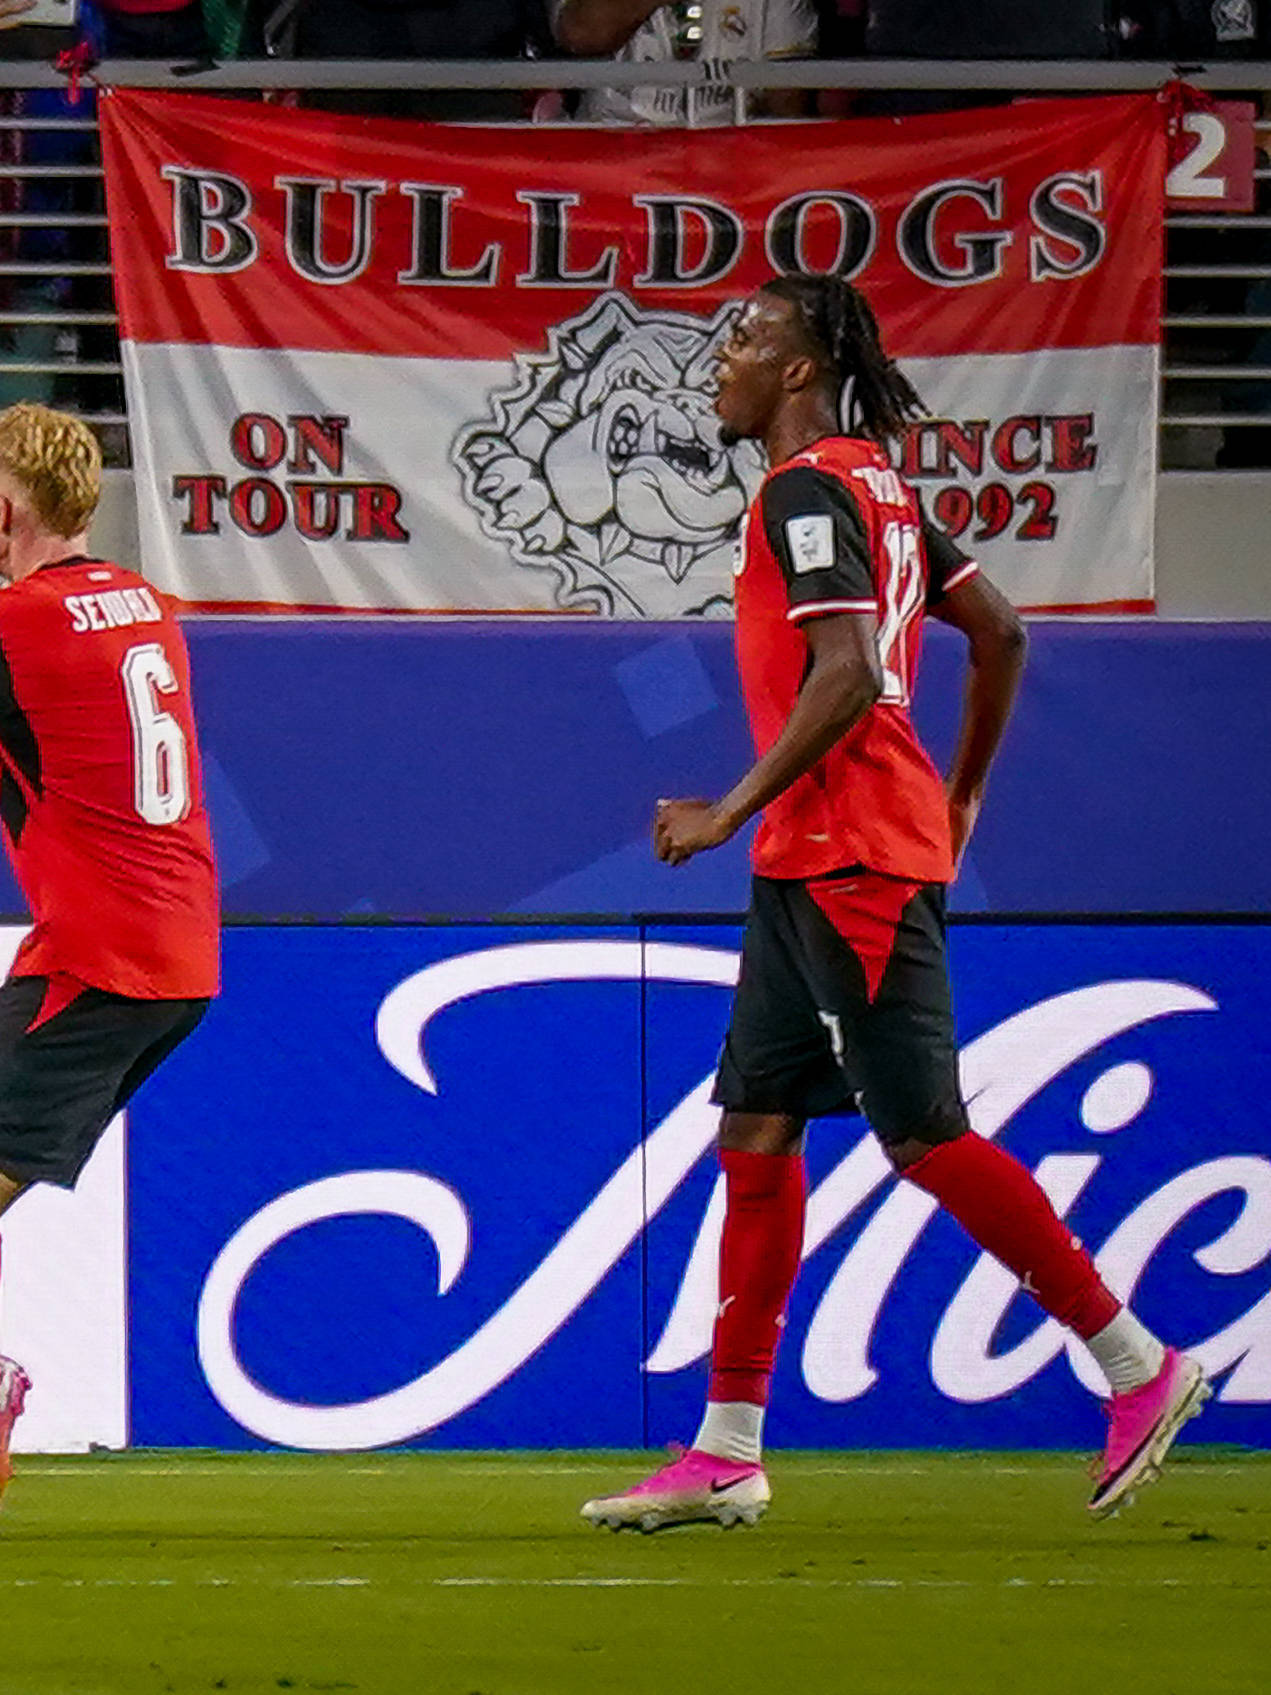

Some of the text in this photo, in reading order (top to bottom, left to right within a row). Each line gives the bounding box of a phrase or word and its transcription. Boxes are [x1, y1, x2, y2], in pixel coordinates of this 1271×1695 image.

[1165, 112, 1226, 198] 2
[161, 163, 1107, 288] BULLDOGS
[230, 411, 350, 475] ON
[900, 411, 1099, 478] INCE
[173, 474, 410, 543] TOUR
[920, 481, 1059, 543] 992
[121, 643, 191, 826] 6
